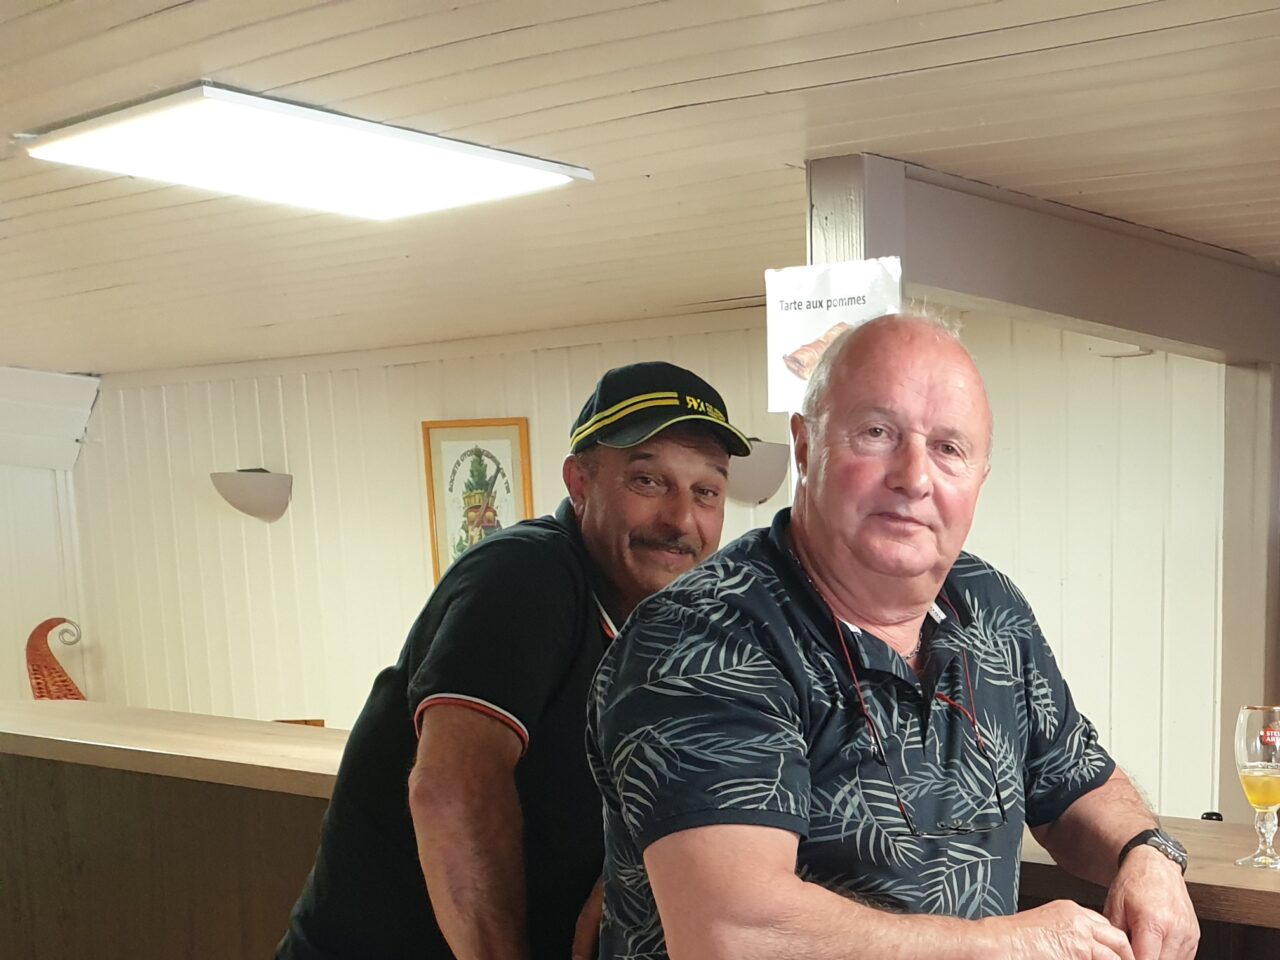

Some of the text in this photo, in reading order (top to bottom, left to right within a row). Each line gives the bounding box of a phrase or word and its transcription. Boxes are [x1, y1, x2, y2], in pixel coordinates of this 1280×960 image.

[779, 295, 866, 311] Tarte aux pommes
